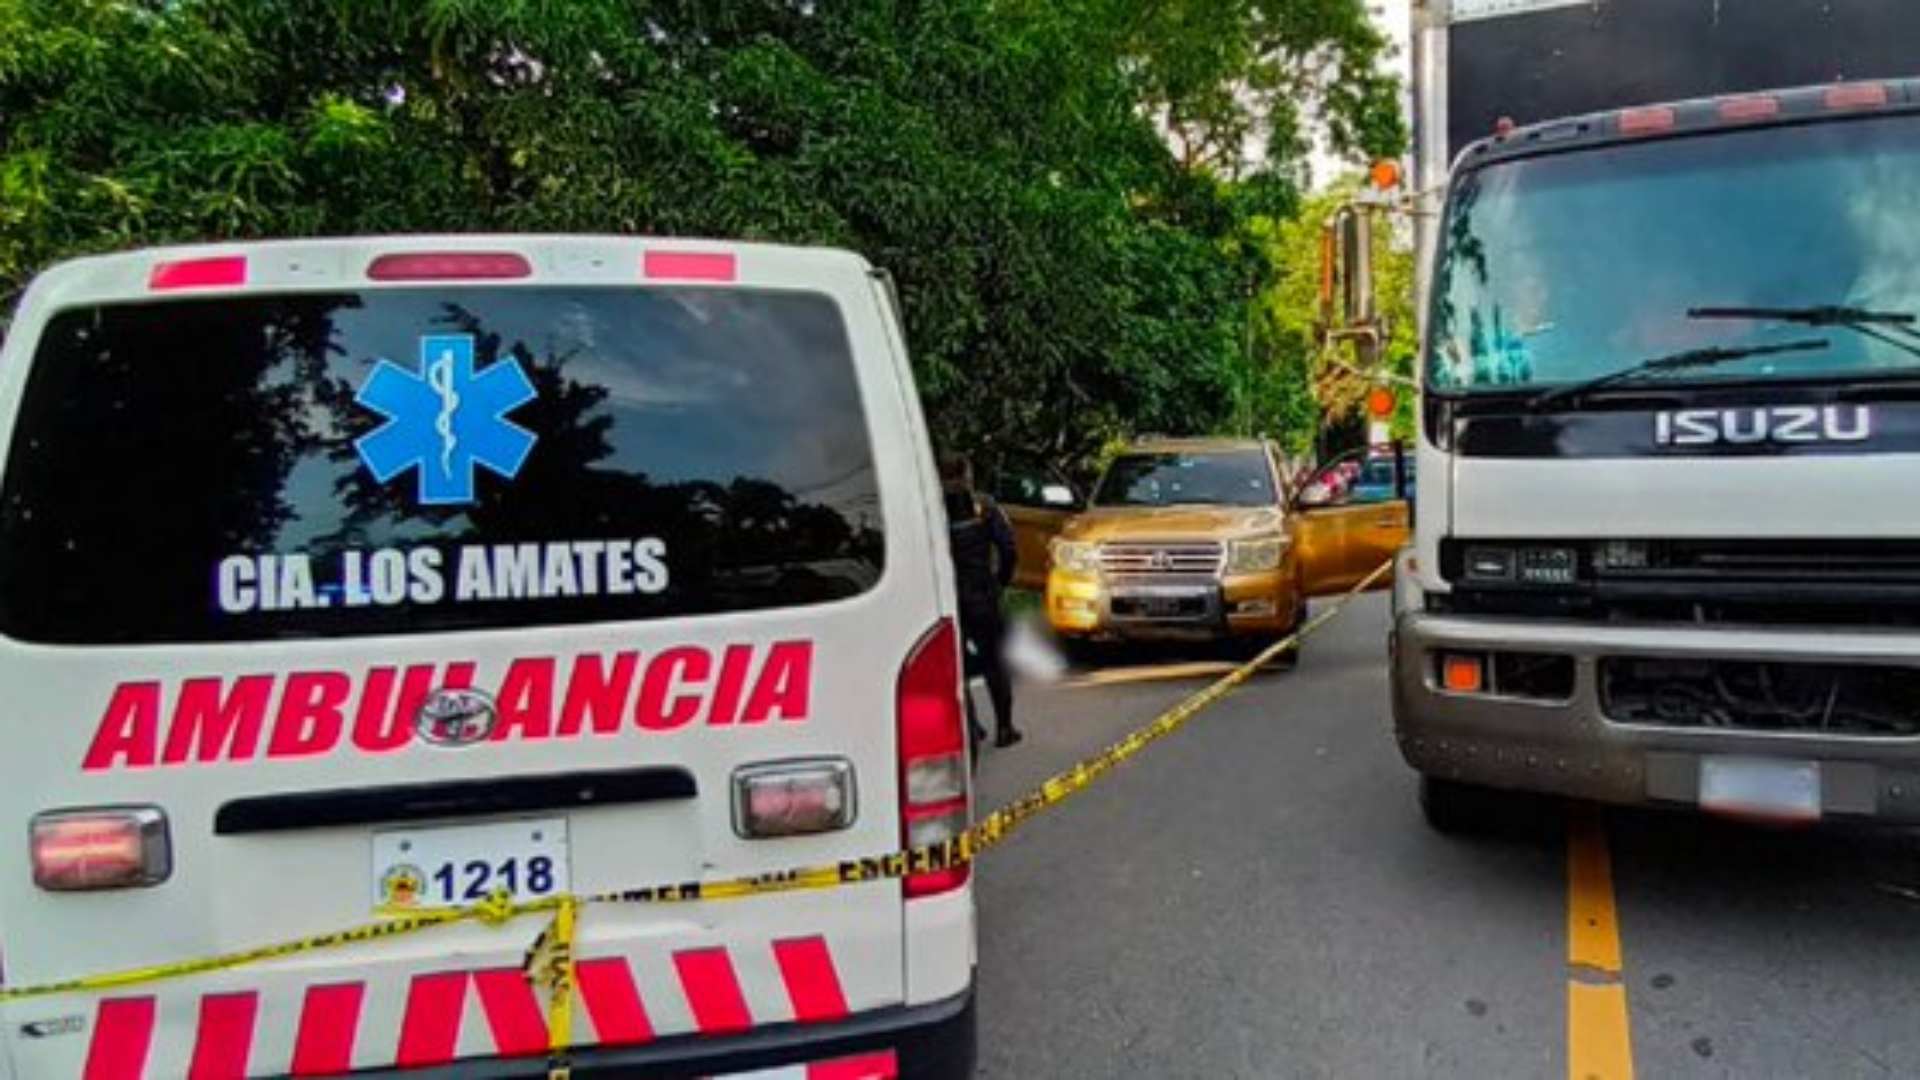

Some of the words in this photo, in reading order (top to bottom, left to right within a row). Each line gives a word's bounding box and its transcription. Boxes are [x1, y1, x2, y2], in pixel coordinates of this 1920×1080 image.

[1655, 405, 1870, 445] ISUZU
[217, 554, 330, 613] CIA.
[343, 547, 444, 606] LOS
[455, 537, 669, 600] AMATES
[433, 855, 553, 902] 1218
